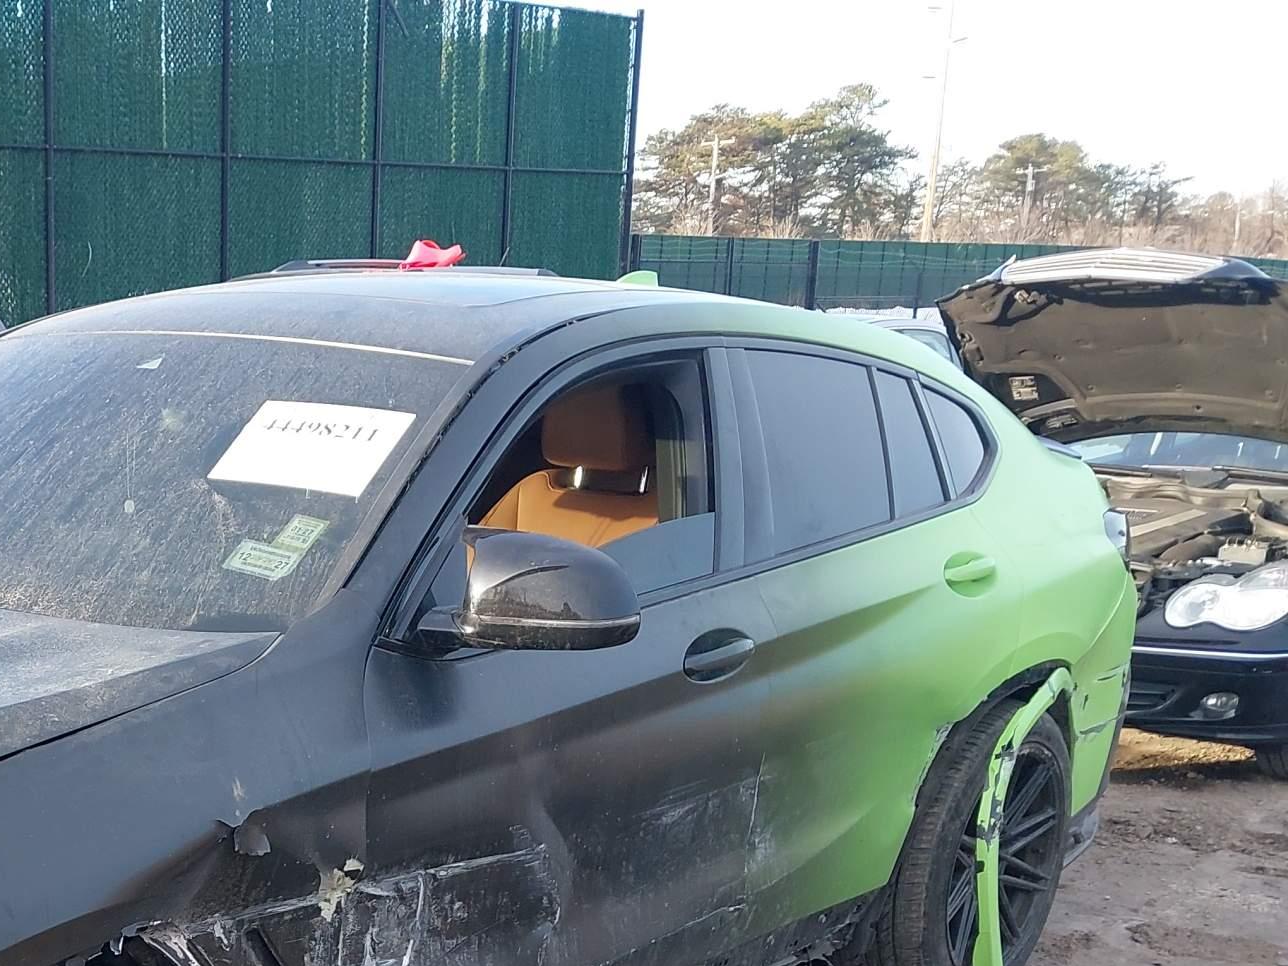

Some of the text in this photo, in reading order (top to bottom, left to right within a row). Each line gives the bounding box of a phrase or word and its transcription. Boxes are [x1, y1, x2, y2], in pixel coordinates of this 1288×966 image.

[264, 418, 379, 442] 44498211
[238, 551, 254, 562] 12
[273, 560, 290, 571] 27
